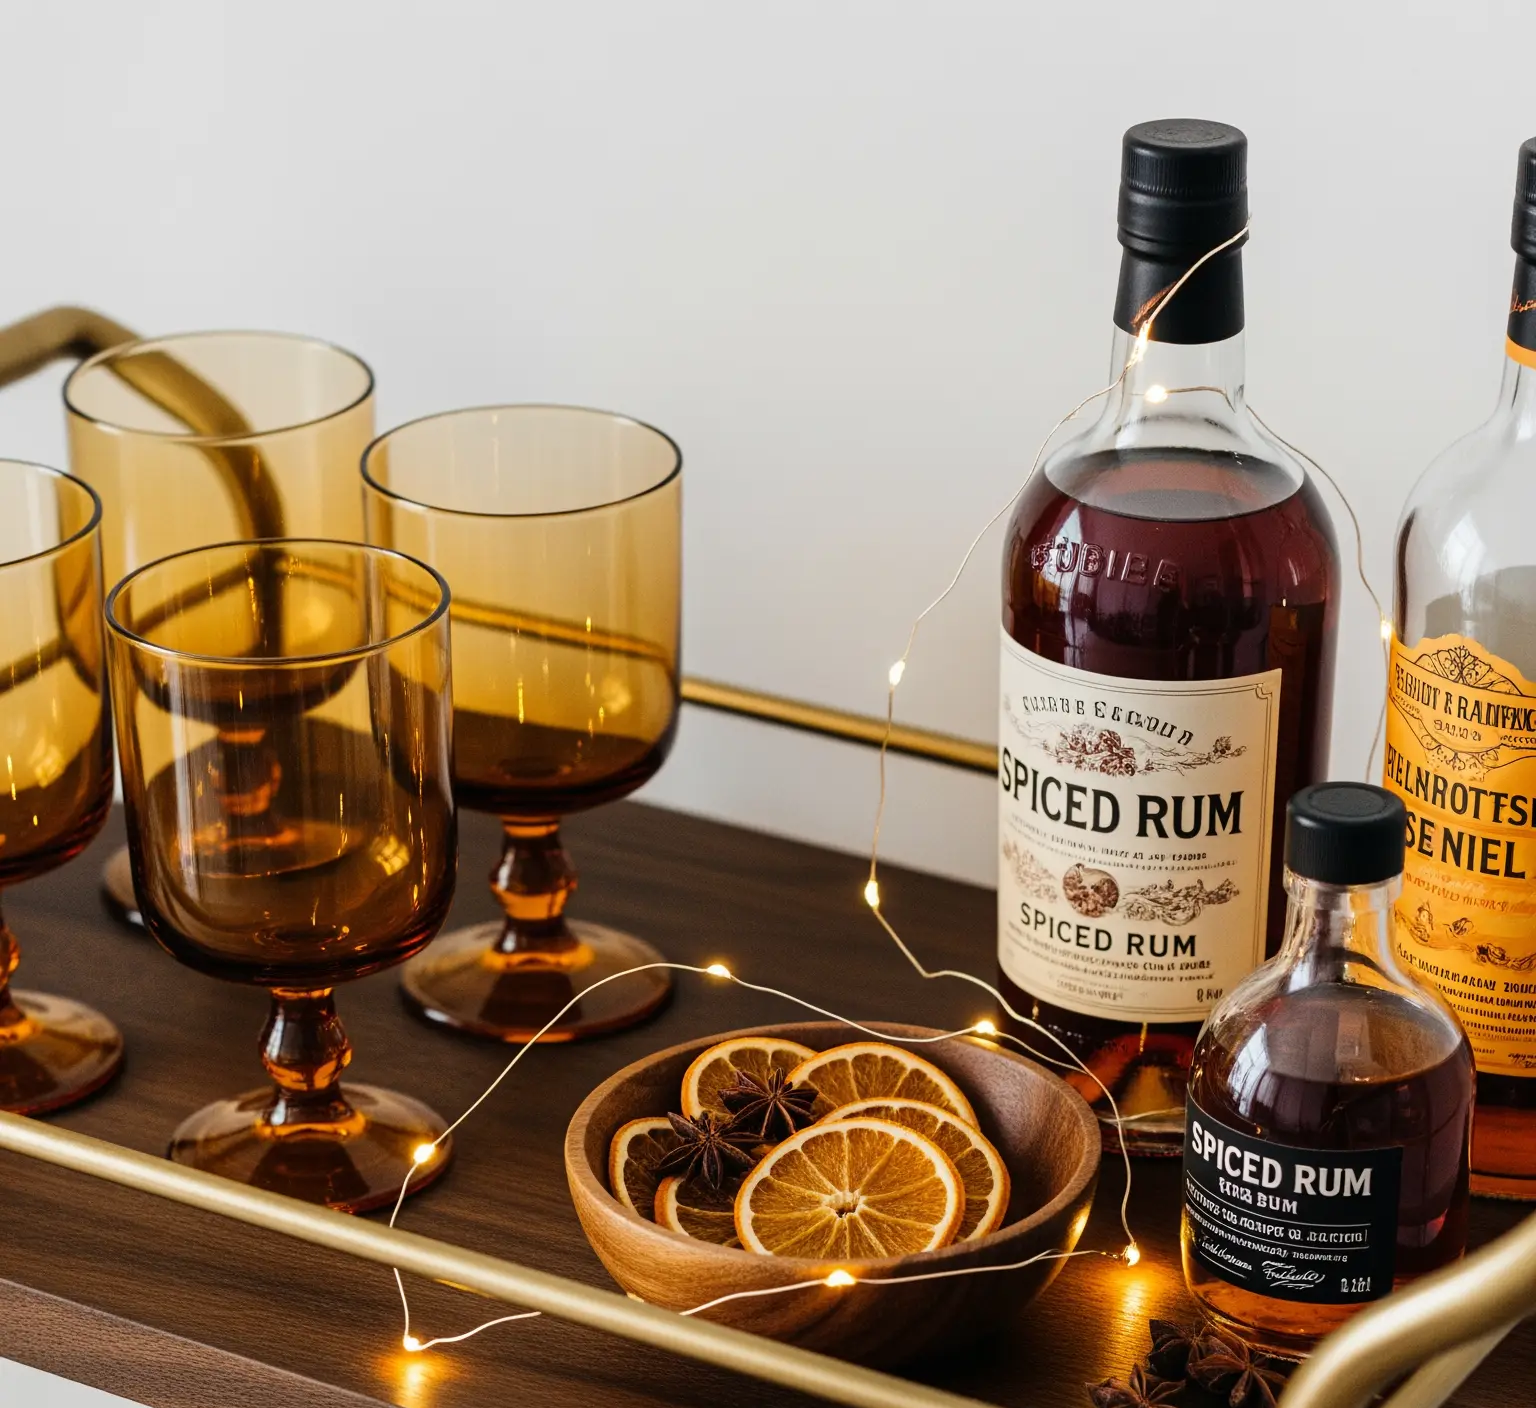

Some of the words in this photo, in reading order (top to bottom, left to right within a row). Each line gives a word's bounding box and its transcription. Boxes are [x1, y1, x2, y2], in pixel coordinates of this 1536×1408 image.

[1001, 746, 1121, 834] SPICED
[1135, 790, 1245, 840] RUM
[1440, 825, 1526, 880] NIEL
[1020, 902, 1113, 952] SPICED
[1126, 932, 1197, 958] RUM
[1191, 1120, 1283, 1190] SPICED
[1293, 1163, 1373, 1198] RUM
